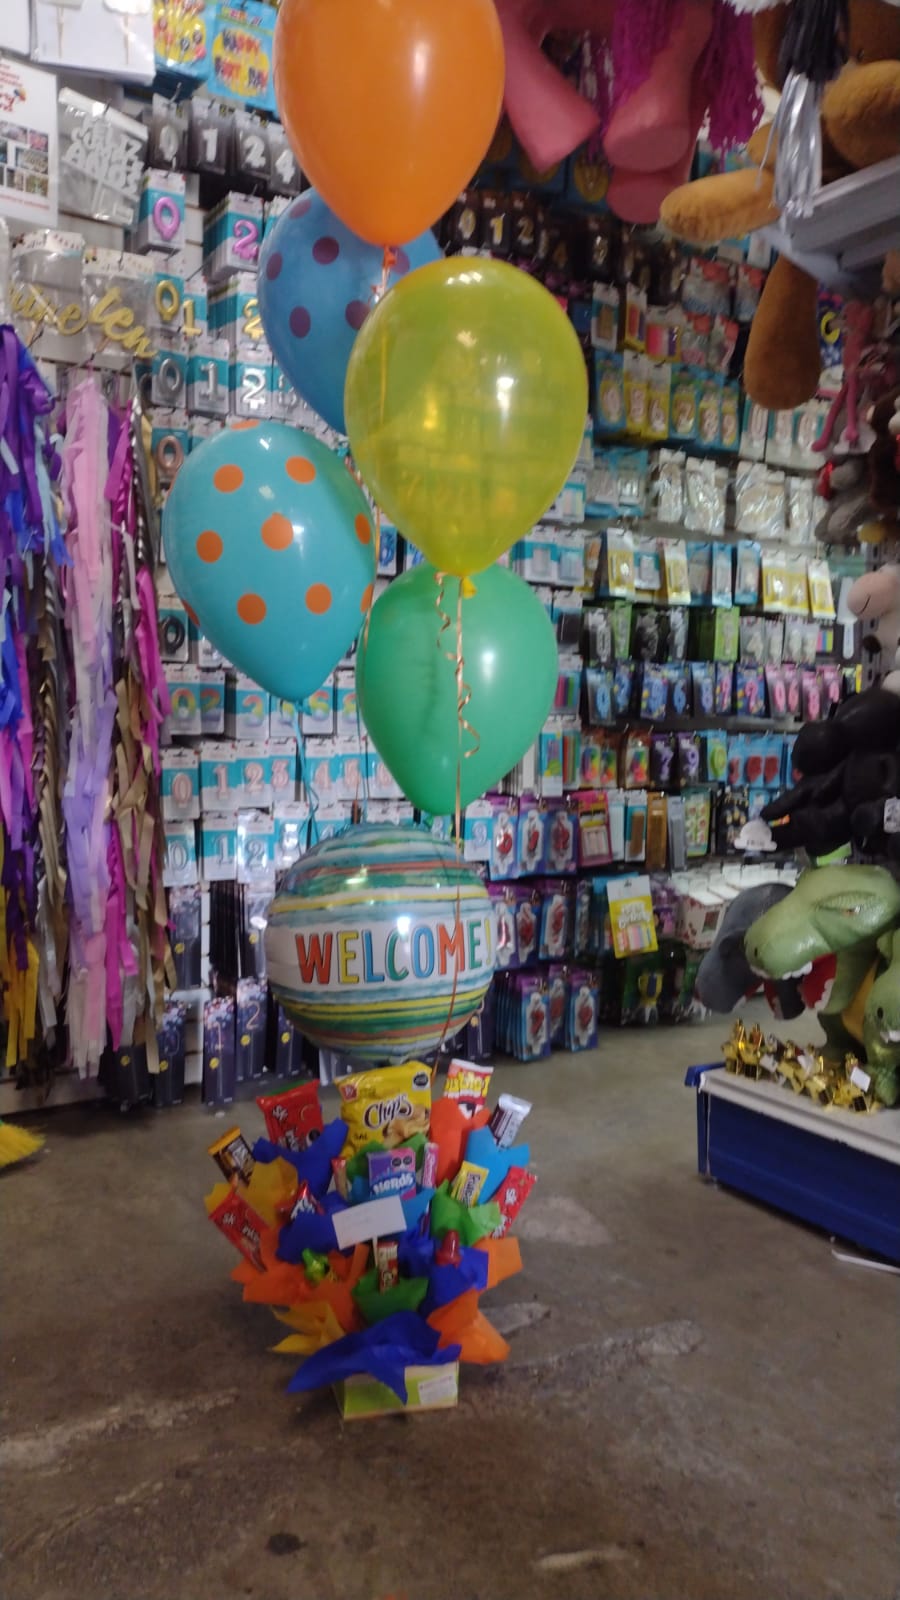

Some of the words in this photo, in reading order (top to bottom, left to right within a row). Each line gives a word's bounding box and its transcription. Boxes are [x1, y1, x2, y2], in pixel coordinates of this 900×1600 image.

[159, 125, 179, 161] 0
[202, 127, 219, 162] 1
[242, 135, 267, 168] 2
[274, 149, 295, 184] 4
[153, 196, 181, 241] 0
[490, 216, 504, 245] 1
[517, 217, 534, 246] 2
[232, 219, 260, 260] 2
[155, 280, 180, 321] 0
[182, 298, 202, 335] 1
[243, 298, 264, 339] 2
[158, 357, 184, 396] 0
[201, 361, 220, 400] 1
[241, 366, 267, 409] 2
[157, 435, 184, 474] 0
[164, 615, 186, 655] 0
[171, 687, 197, 723] 0
[201, 687, 221, 723] 2
[243, 694, 265, 727] 3
[310, 690, 329, 722] 6
[245, 761, 264, 794] 2
[657, 750, 674, 779] 7
[687, 749, 699, 776] 9
[172, 772, 193, 808] 0
[213, 763, 230, 799] 1
[170, 839, 190, 872] 0
[212, 834, 233, 865] 1
[244, 839, 265, 870] 2
[295, 917, 492, 985] WELCOME!
[246, 1000, 262, 1031] 2
[363, 1091, 415, 1130] Chips
